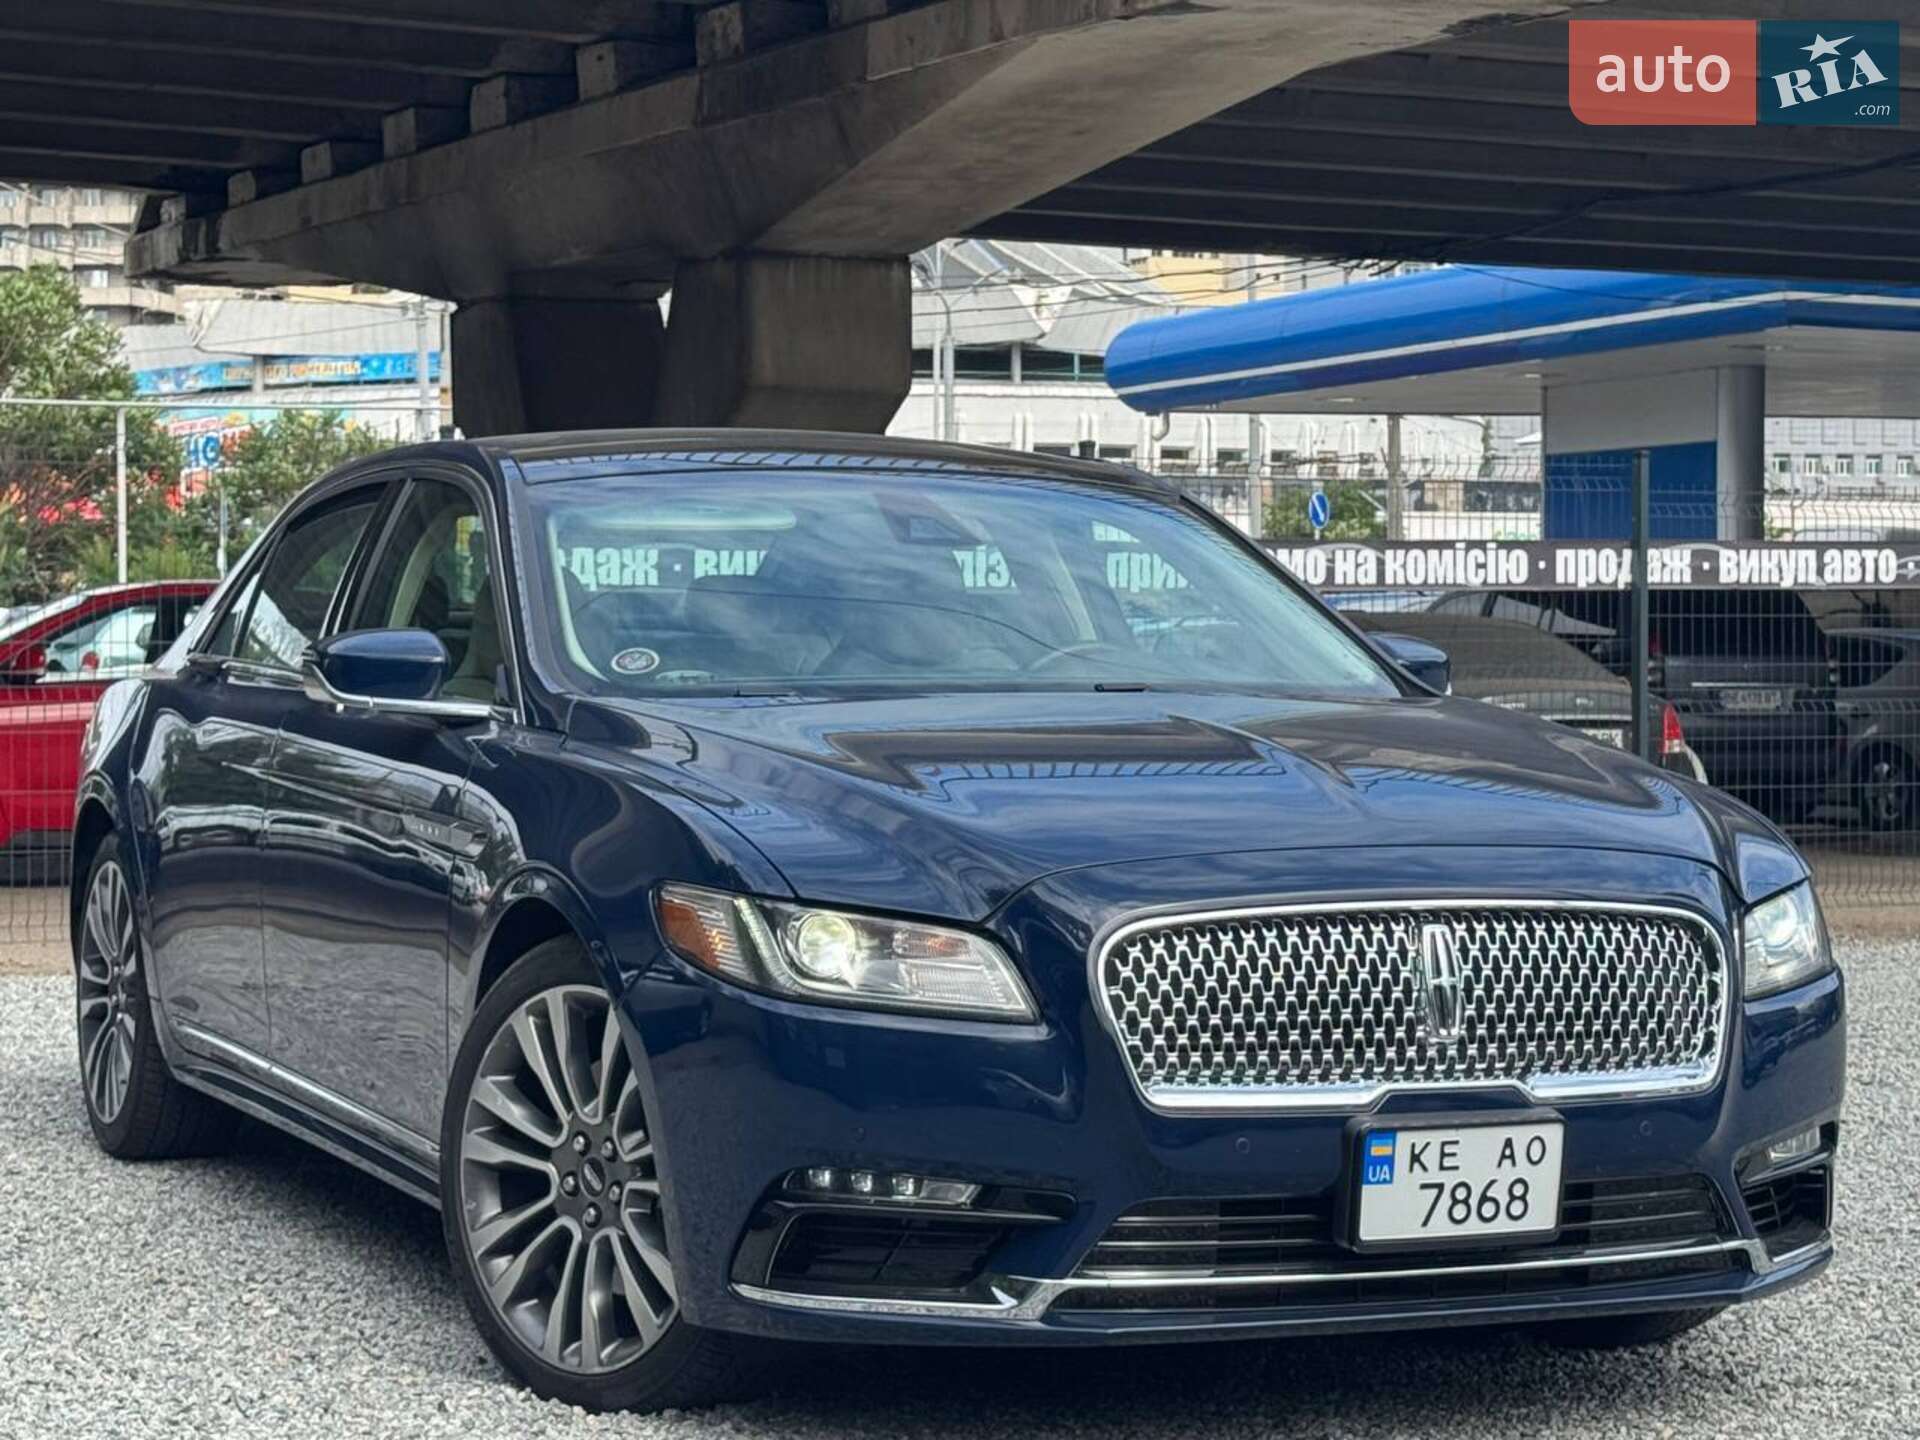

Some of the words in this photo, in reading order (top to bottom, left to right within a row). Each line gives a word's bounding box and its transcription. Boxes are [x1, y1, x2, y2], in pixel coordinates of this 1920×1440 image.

[1334, 549, 1377, 585] на
[1384, 542, 1529, 586] комісію
[1718, 549, 1819, 589] викуп
[1823, 549, 1897, 585] авто
[1368, 1164, 1391, 1182] UA
[1409, 1140, 1460, 1174] KE
[1419, 1177, 1530, 1228] 7868
